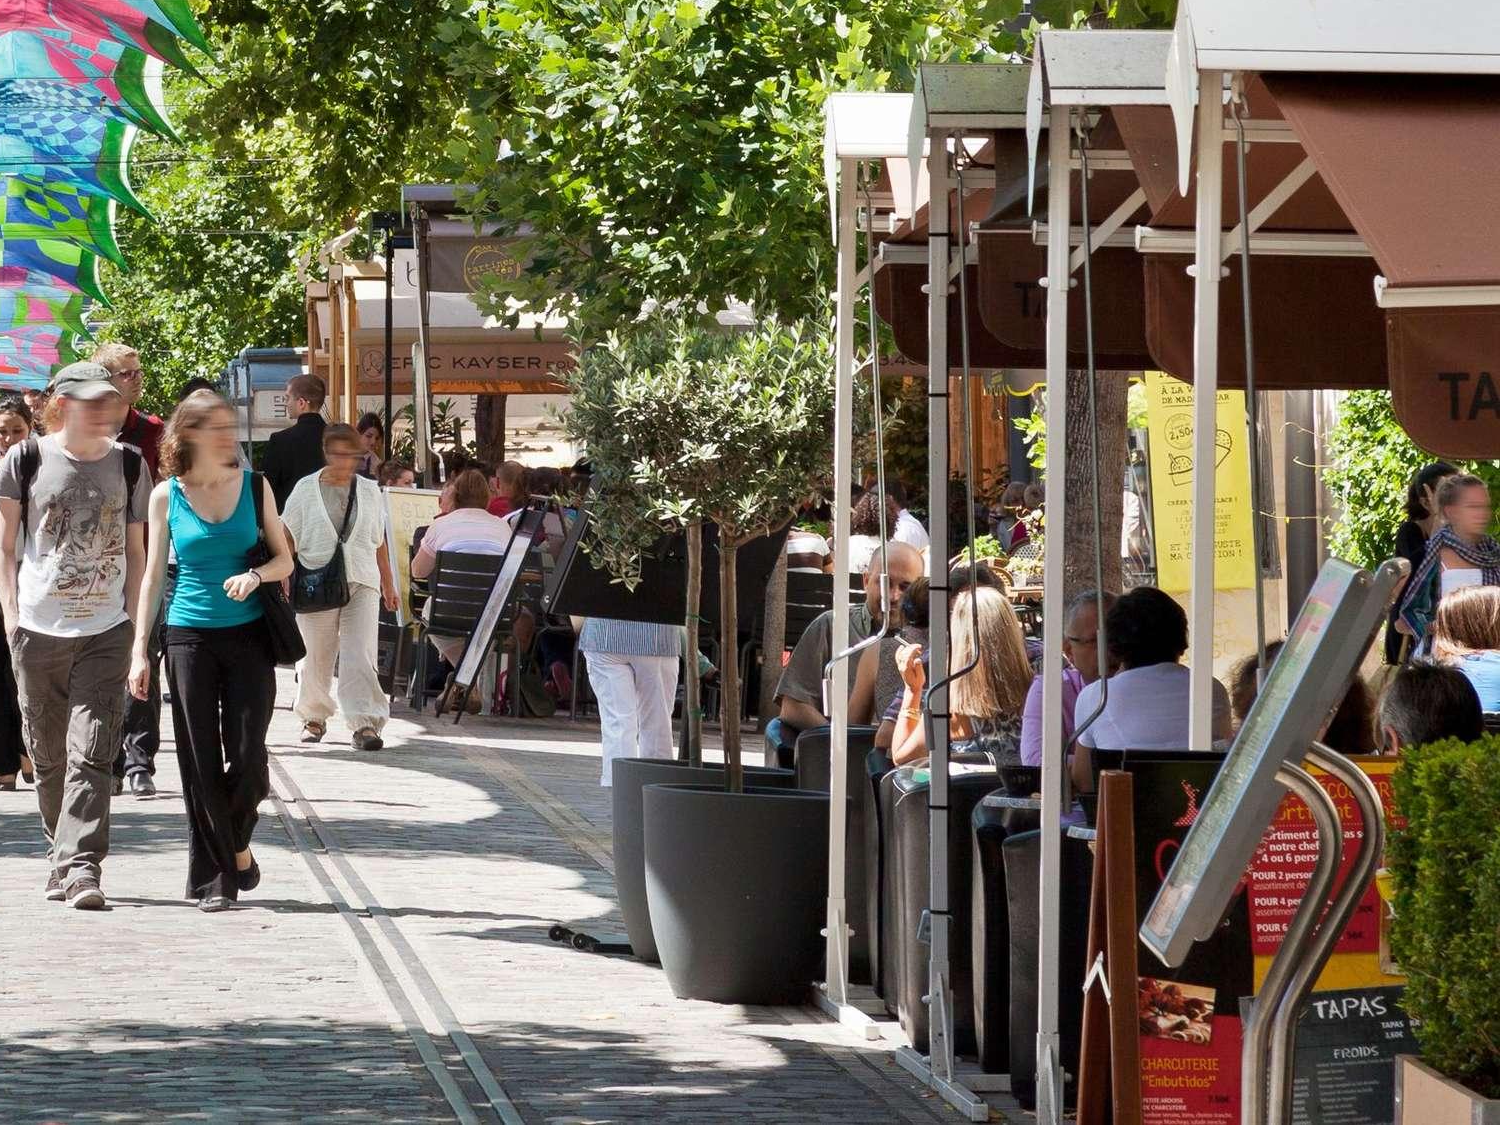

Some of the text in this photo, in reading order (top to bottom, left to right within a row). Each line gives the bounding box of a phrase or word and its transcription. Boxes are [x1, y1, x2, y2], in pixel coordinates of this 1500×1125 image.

[390, 356, 442, 370] ERC
[452, 356, 541, 370] KAYSER
[1171, 386, 1184, 394] LA
[1168, 426, 1193, 441] 2,50
[1269, 831, 1311, 841] rtiment
[1269, 843, 1297, 852] notre
[1261, 854, 1269, 863] 4
[1270, 855, 1284, 863] ou
[1285, 854, 1293, 863] 6
[1252, 872, 1277, 881] POUR
[1278, 871, 1284, 880] 2
[1254, 898, 1279, 907] POUR
[1279, 898, 1286, 906] 4
[1256, 923, 1281, 932] POUR
[1313, 996, 1388, 1020] TAPAS
[1380, 1020, 1405, 1029] TAPAS
[1333, 1046, 1380, 1060] FROIDS
[1140, 1058, 1220, 1071] CHARCUTERIE
